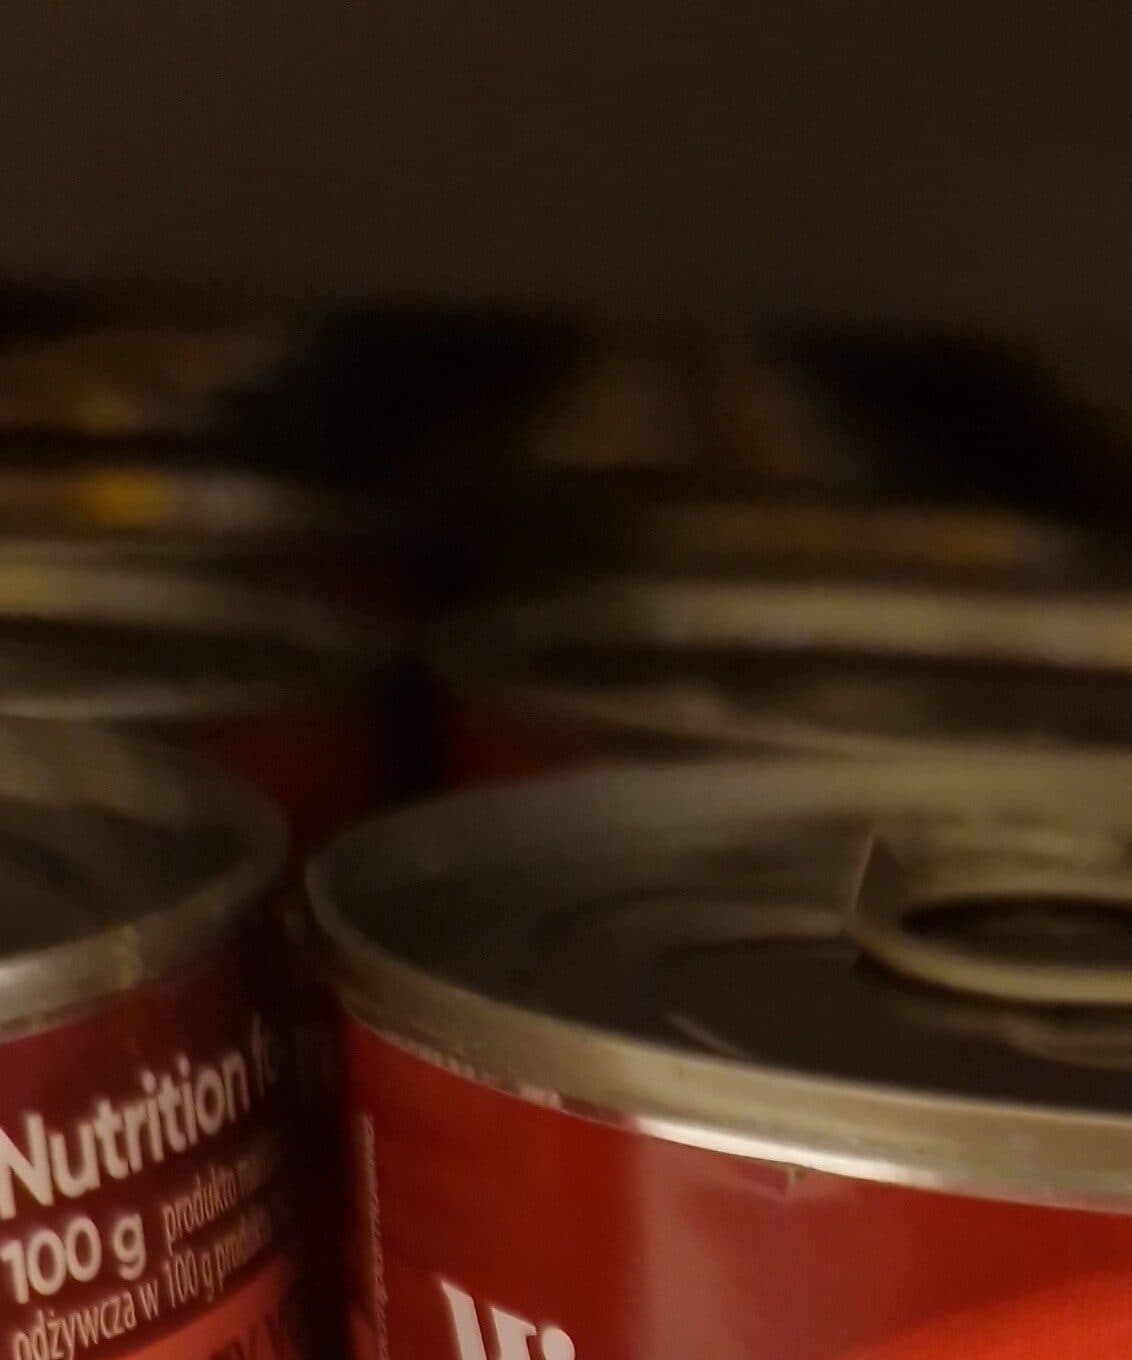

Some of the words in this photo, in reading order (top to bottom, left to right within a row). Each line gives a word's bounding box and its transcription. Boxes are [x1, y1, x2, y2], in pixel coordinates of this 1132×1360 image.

[0, 1049, 250, 1220] Nutrition
[1, 1216, 101, 1304] 100
[113, 1212, 147, 1280] g
